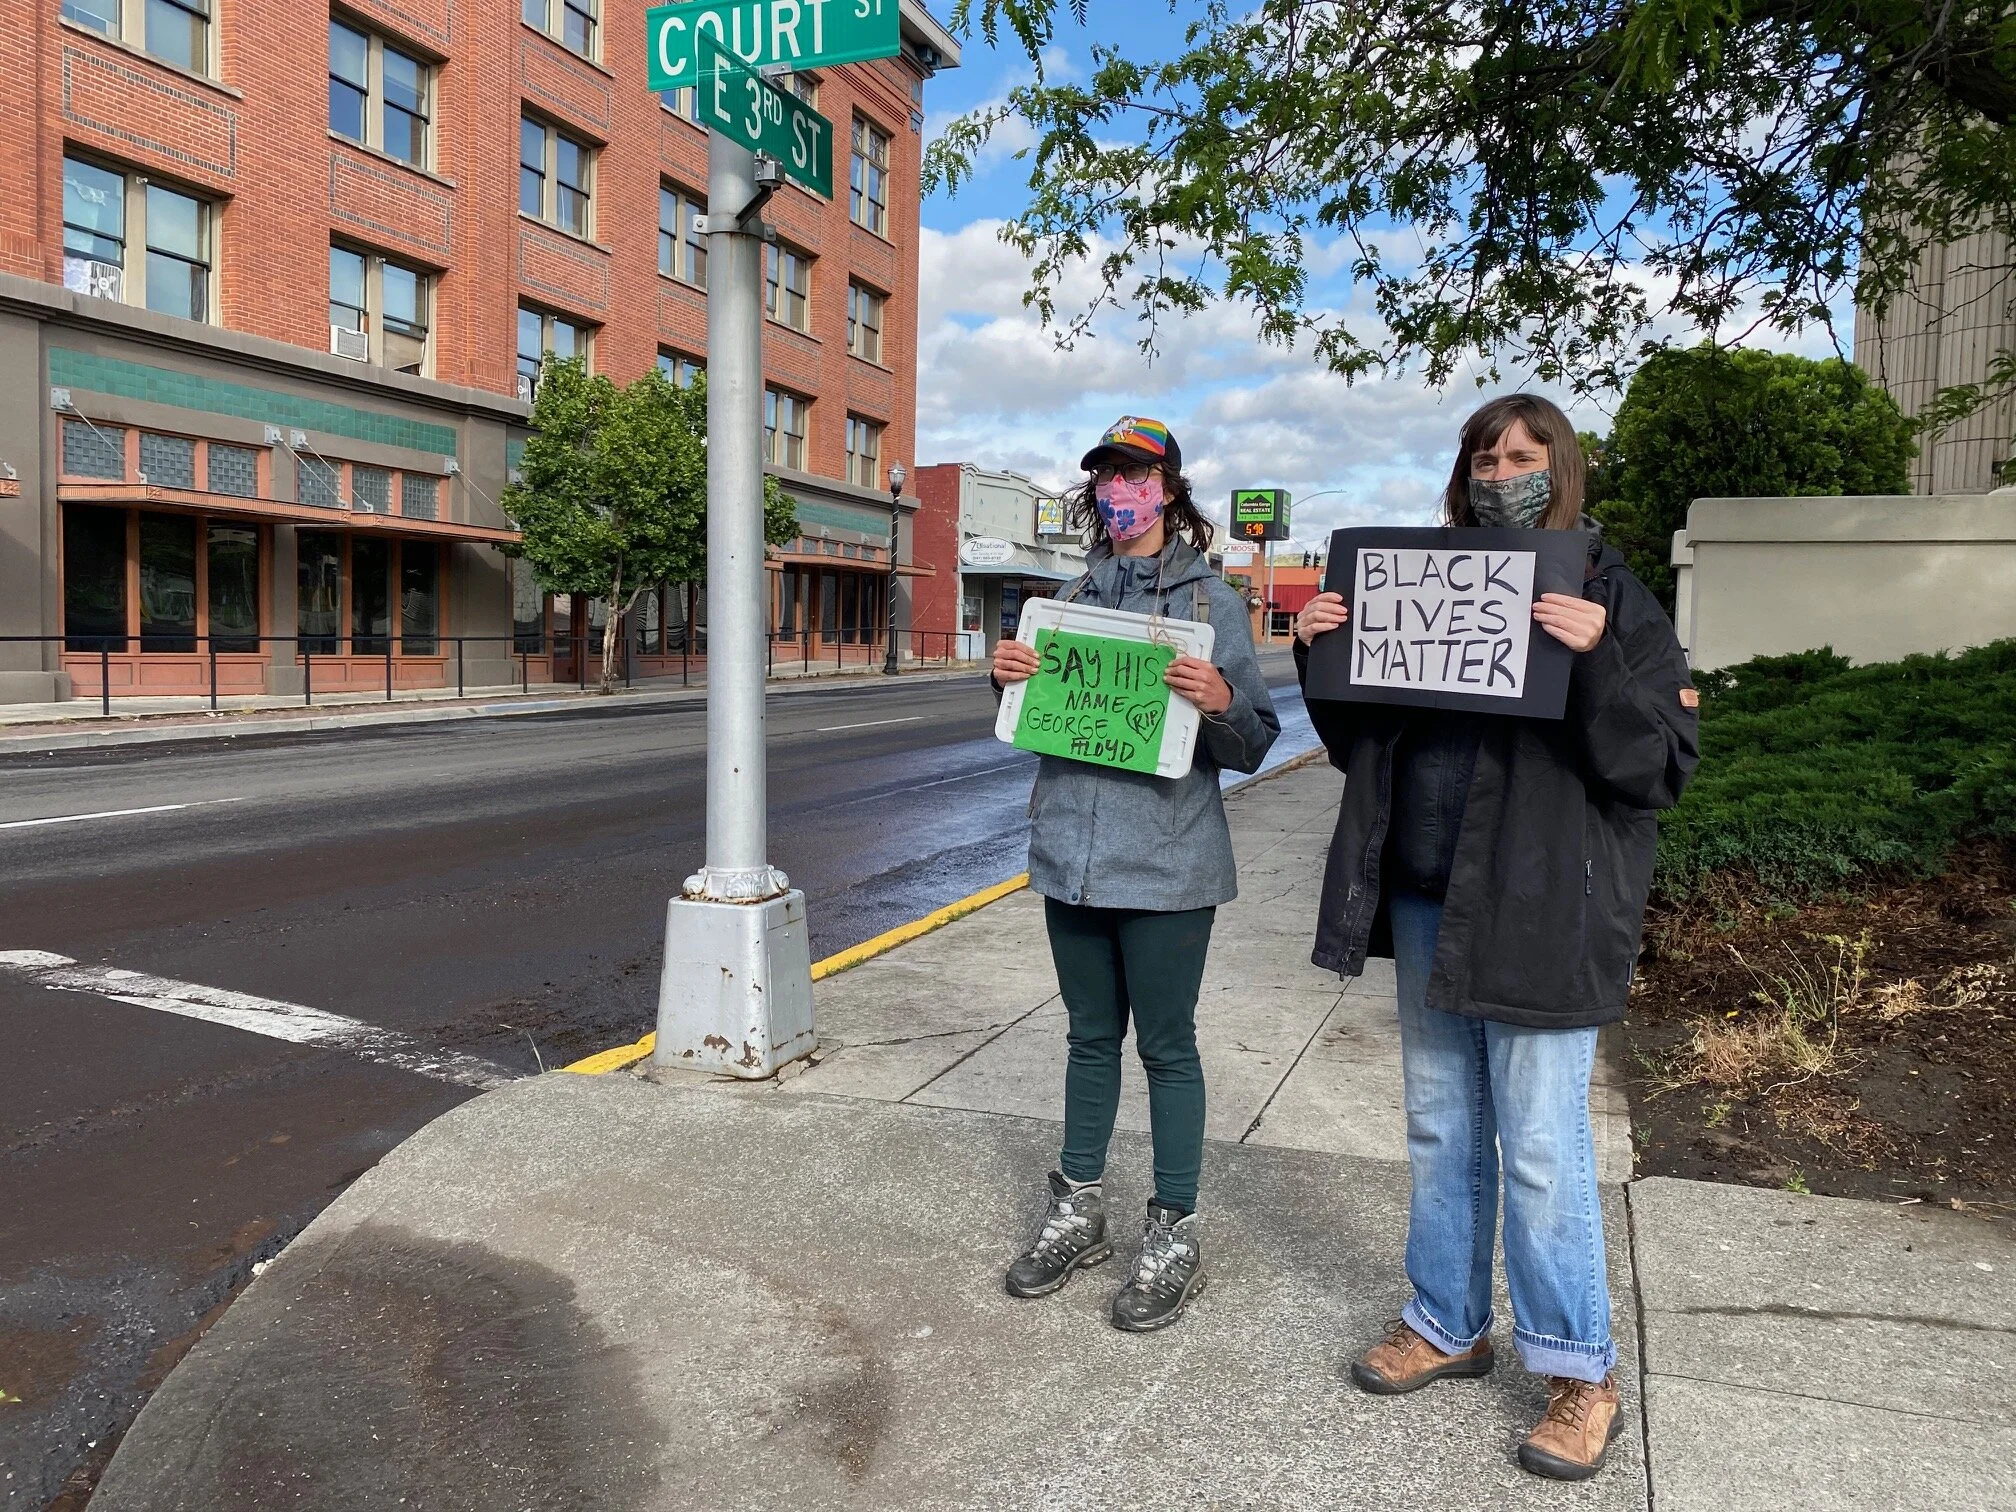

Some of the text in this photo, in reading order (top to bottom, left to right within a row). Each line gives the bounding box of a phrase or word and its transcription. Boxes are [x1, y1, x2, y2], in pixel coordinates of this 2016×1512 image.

[658, 0, 831, 76] COURT
[714, 52, 821, 177] E 3RD ST
[1363, 552, 1520, 595] BLACK
[1360, 599, 1507, 636] LIVES
[1043, 642, 1160, 692] SAY HIS
[1357, 638, 1515, 688] MATTER
[1064, 690, 1130, 713] NAME
[1132, 709, 1159, 735] RIP
[1026, 707, 1109, 740] GEORGE
